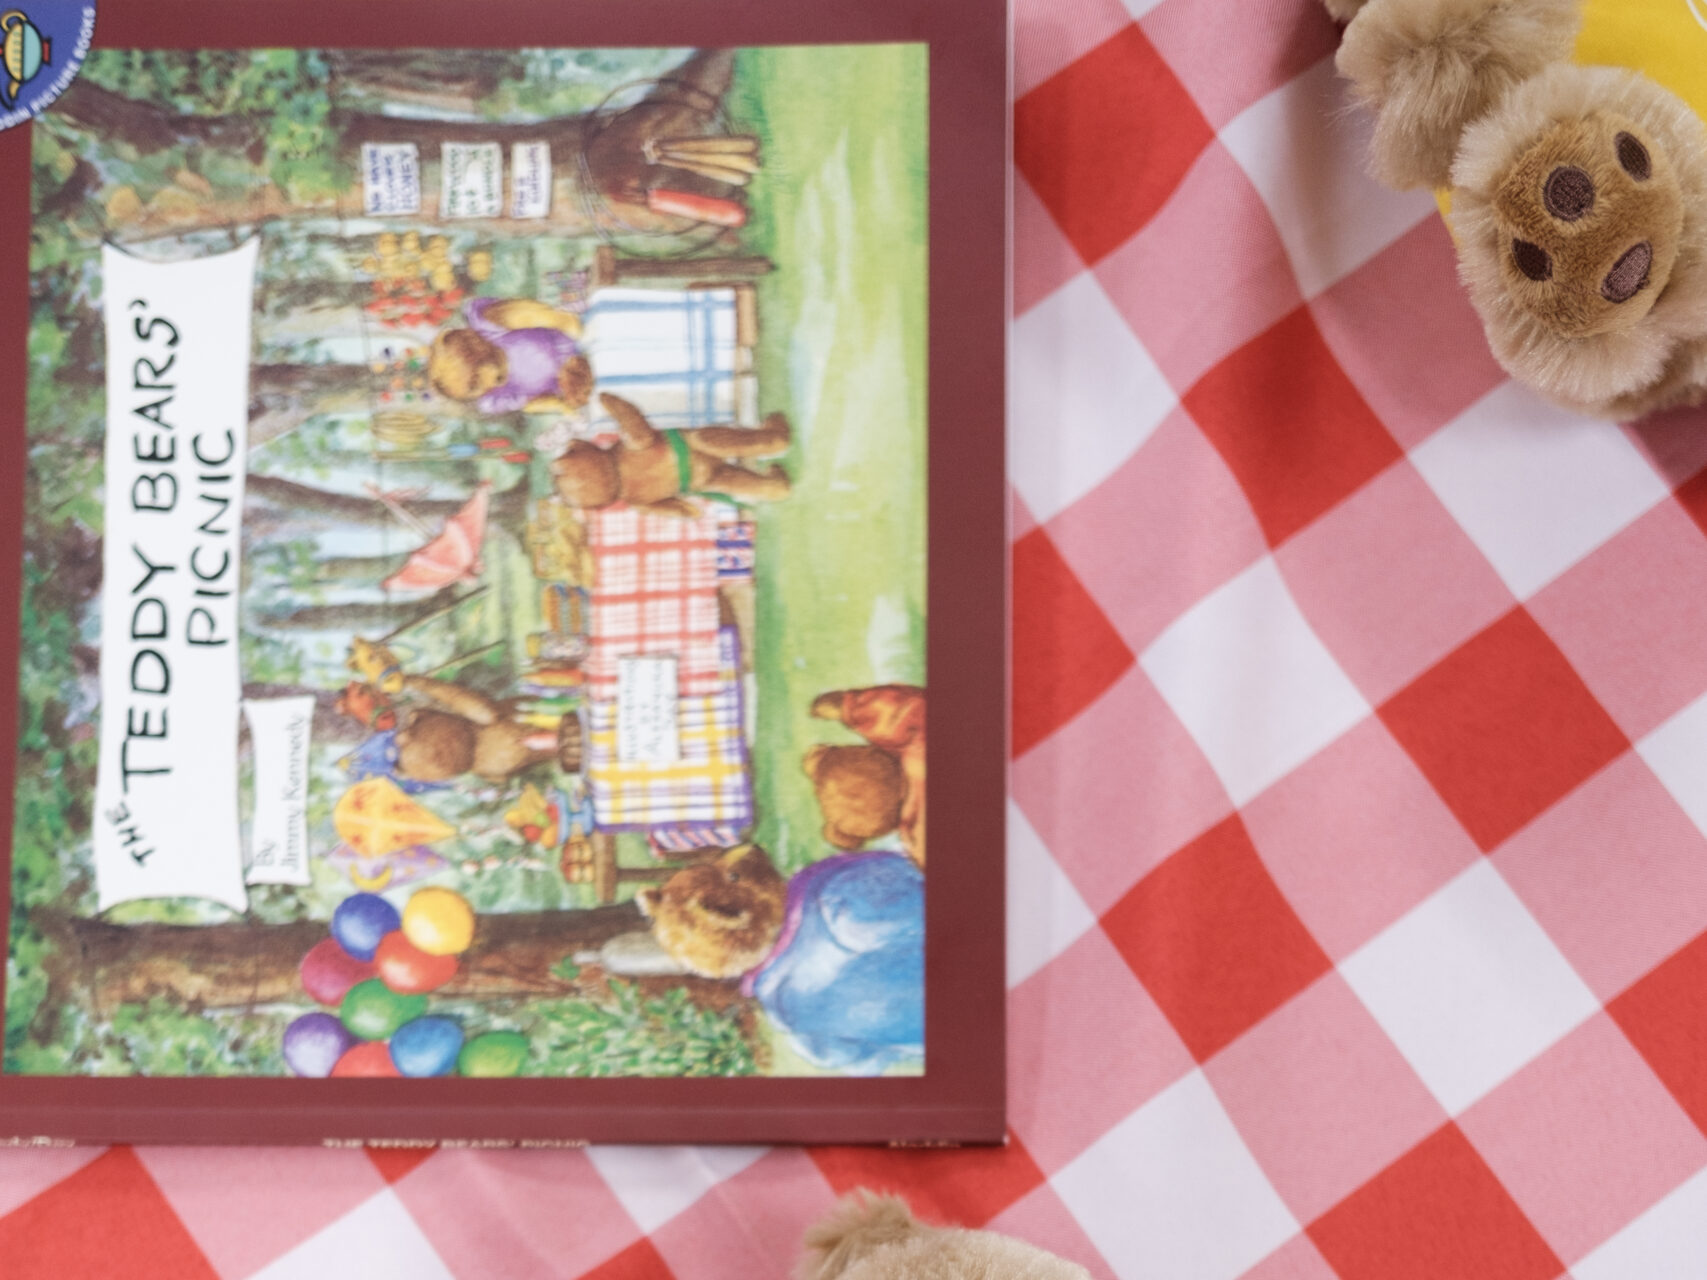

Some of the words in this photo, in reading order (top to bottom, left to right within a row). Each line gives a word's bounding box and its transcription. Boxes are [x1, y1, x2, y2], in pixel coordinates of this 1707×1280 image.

[31, 60, 81, 112] PICTURE
[73, 7, 96, 59] BOOKS
[128, 298, 181, 513] BEARS'
[186, 428, 235, 647] PICNIC
[121, 543, 177, 795] TEDDY
[281, 714, 305, 801] Kennedy
[105, 801, 154, 867] THE
[255, 839, 276, 867] By
[279, 805, 303, 872] Jimmy
